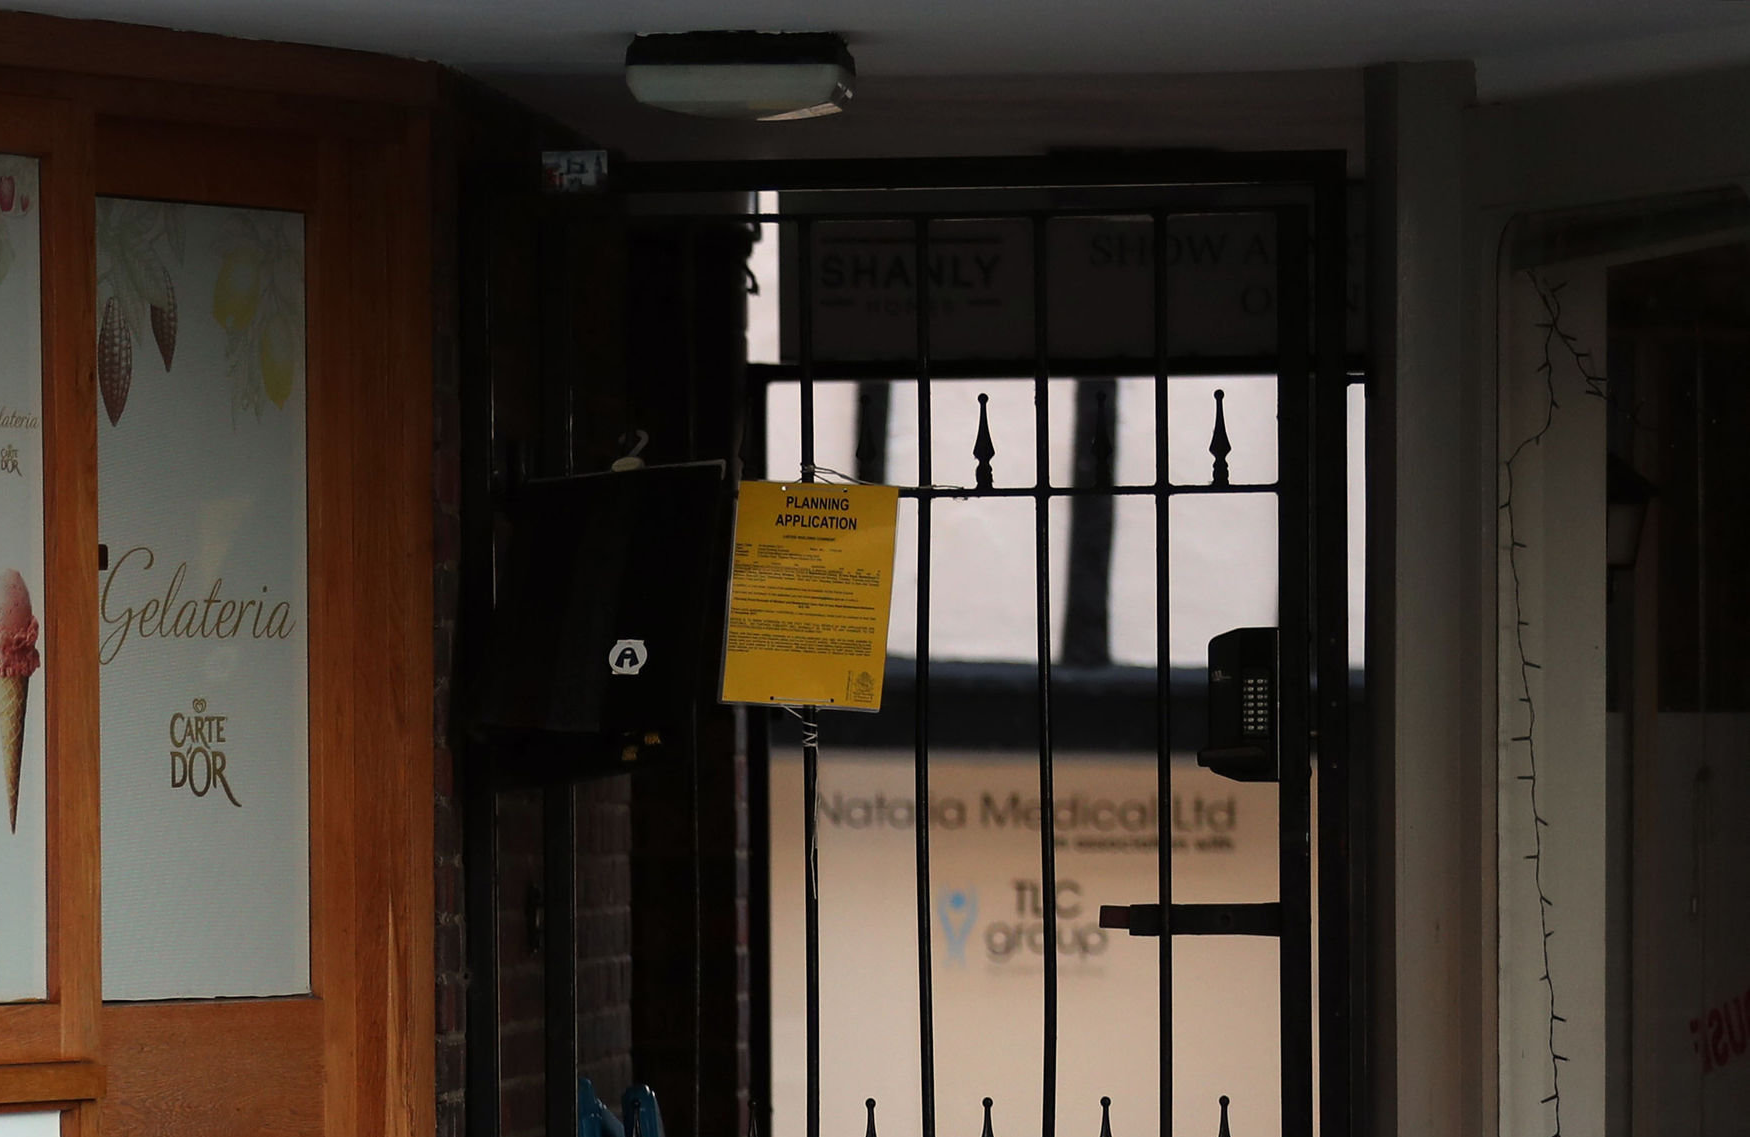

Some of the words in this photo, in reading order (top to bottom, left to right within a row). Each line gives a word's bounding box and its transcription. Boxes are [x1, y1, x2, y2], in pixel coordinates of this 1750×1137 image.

[820, 253, 1001, 289] SHANLY
[786, 496, 849, 511] PLANNING
[775, 514, 857, 530] APPLICATION
[99, 546, 296, 665] Gelateria
[169, 712, 227, 749] CARTE
[816, 790, 968, 832] Nataia
